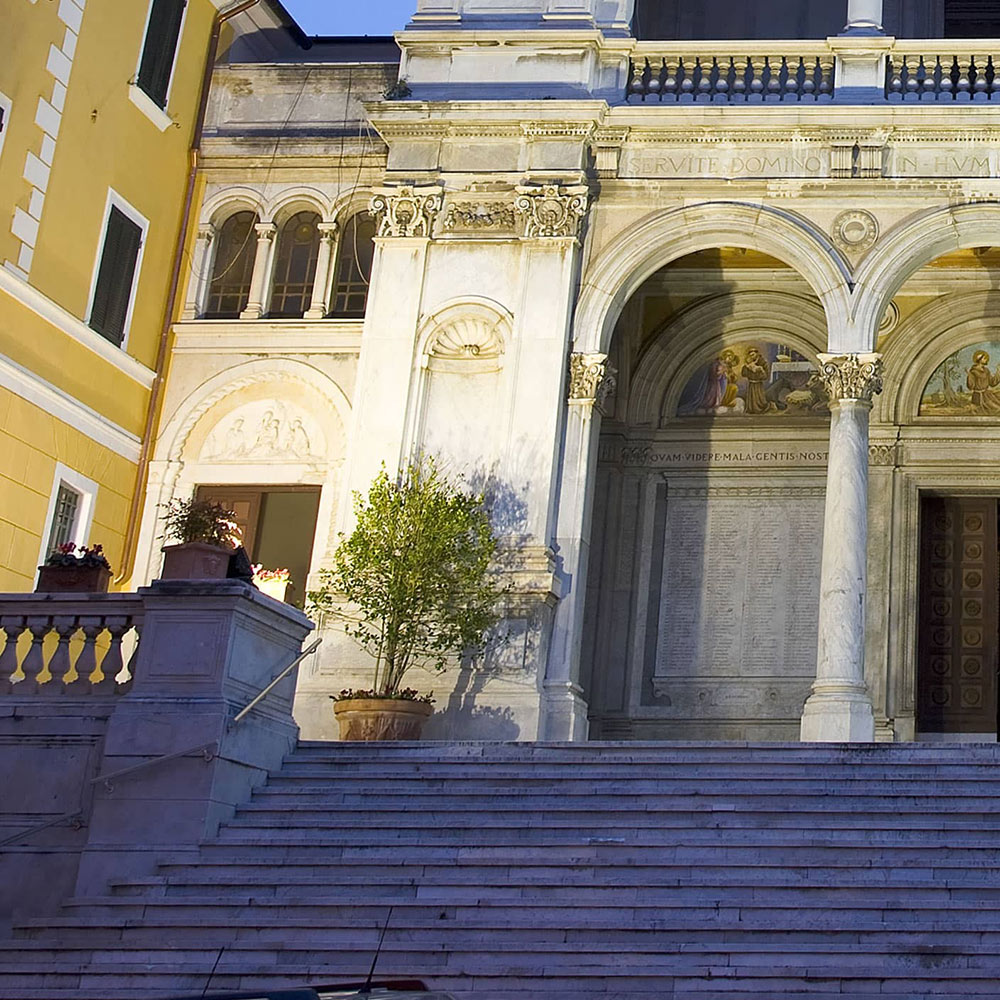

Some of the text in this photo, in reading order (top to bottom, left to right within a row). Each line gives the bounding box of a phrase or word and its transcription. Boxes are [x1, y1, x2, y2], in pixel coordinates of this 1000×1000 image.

[629, 156, 821, 174] SERVITE DOMINO
[685, 452, 721, 462] VIDERE
[722, 452, 752, 461] MALA
